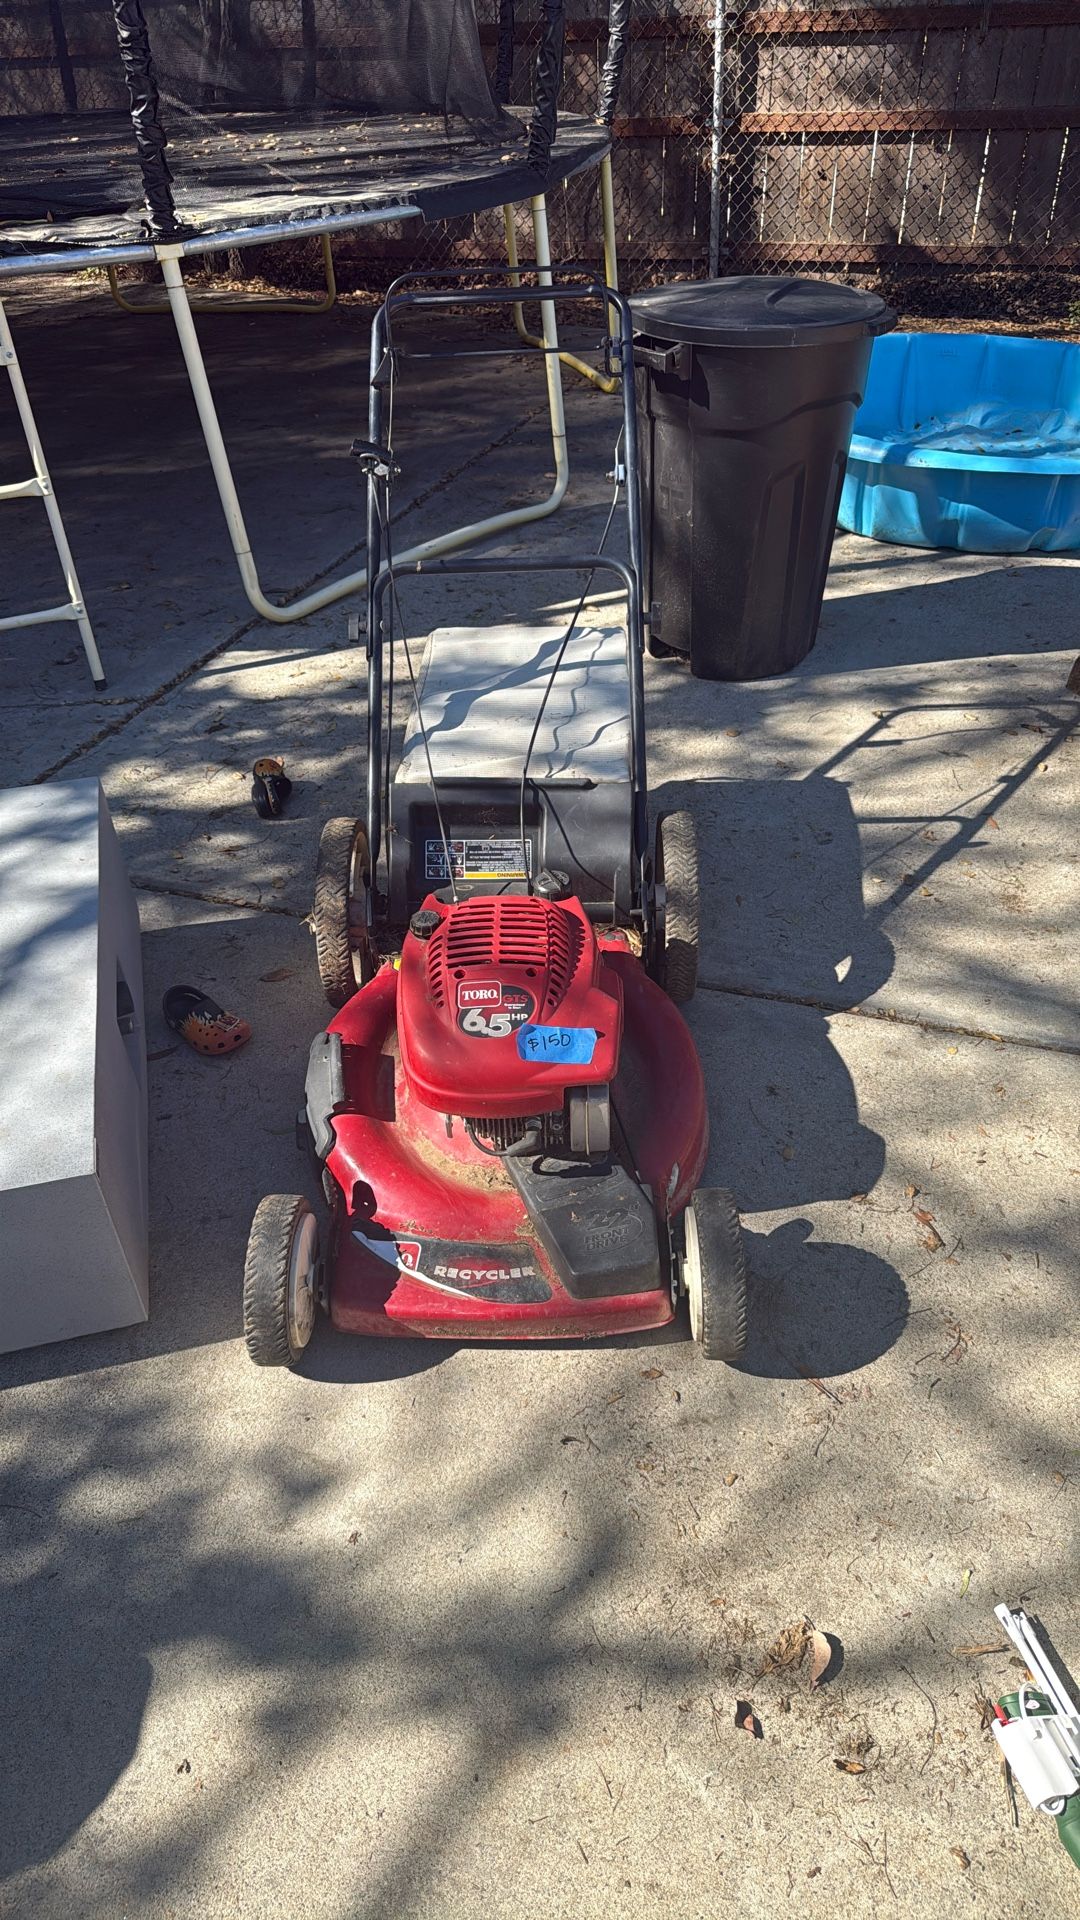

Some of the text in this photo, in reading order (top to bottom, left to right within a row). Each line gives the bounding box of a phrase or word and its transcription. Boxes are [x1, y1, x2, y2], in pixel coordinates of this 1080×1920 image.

[462, 989, 499, 1000] TORO
[503, 994, 528, 1003] GTS
[462, 1008, 511, 1037] 6.5
[511, 1013, 528, 1021] HP
[528, 1033, 571, 1052] $150
[584, 1227, 629, 1244] FRONT
[586, 1236, 628, 1250] DRIVE
[433, 1265, 536, 1280] RECYCLER
